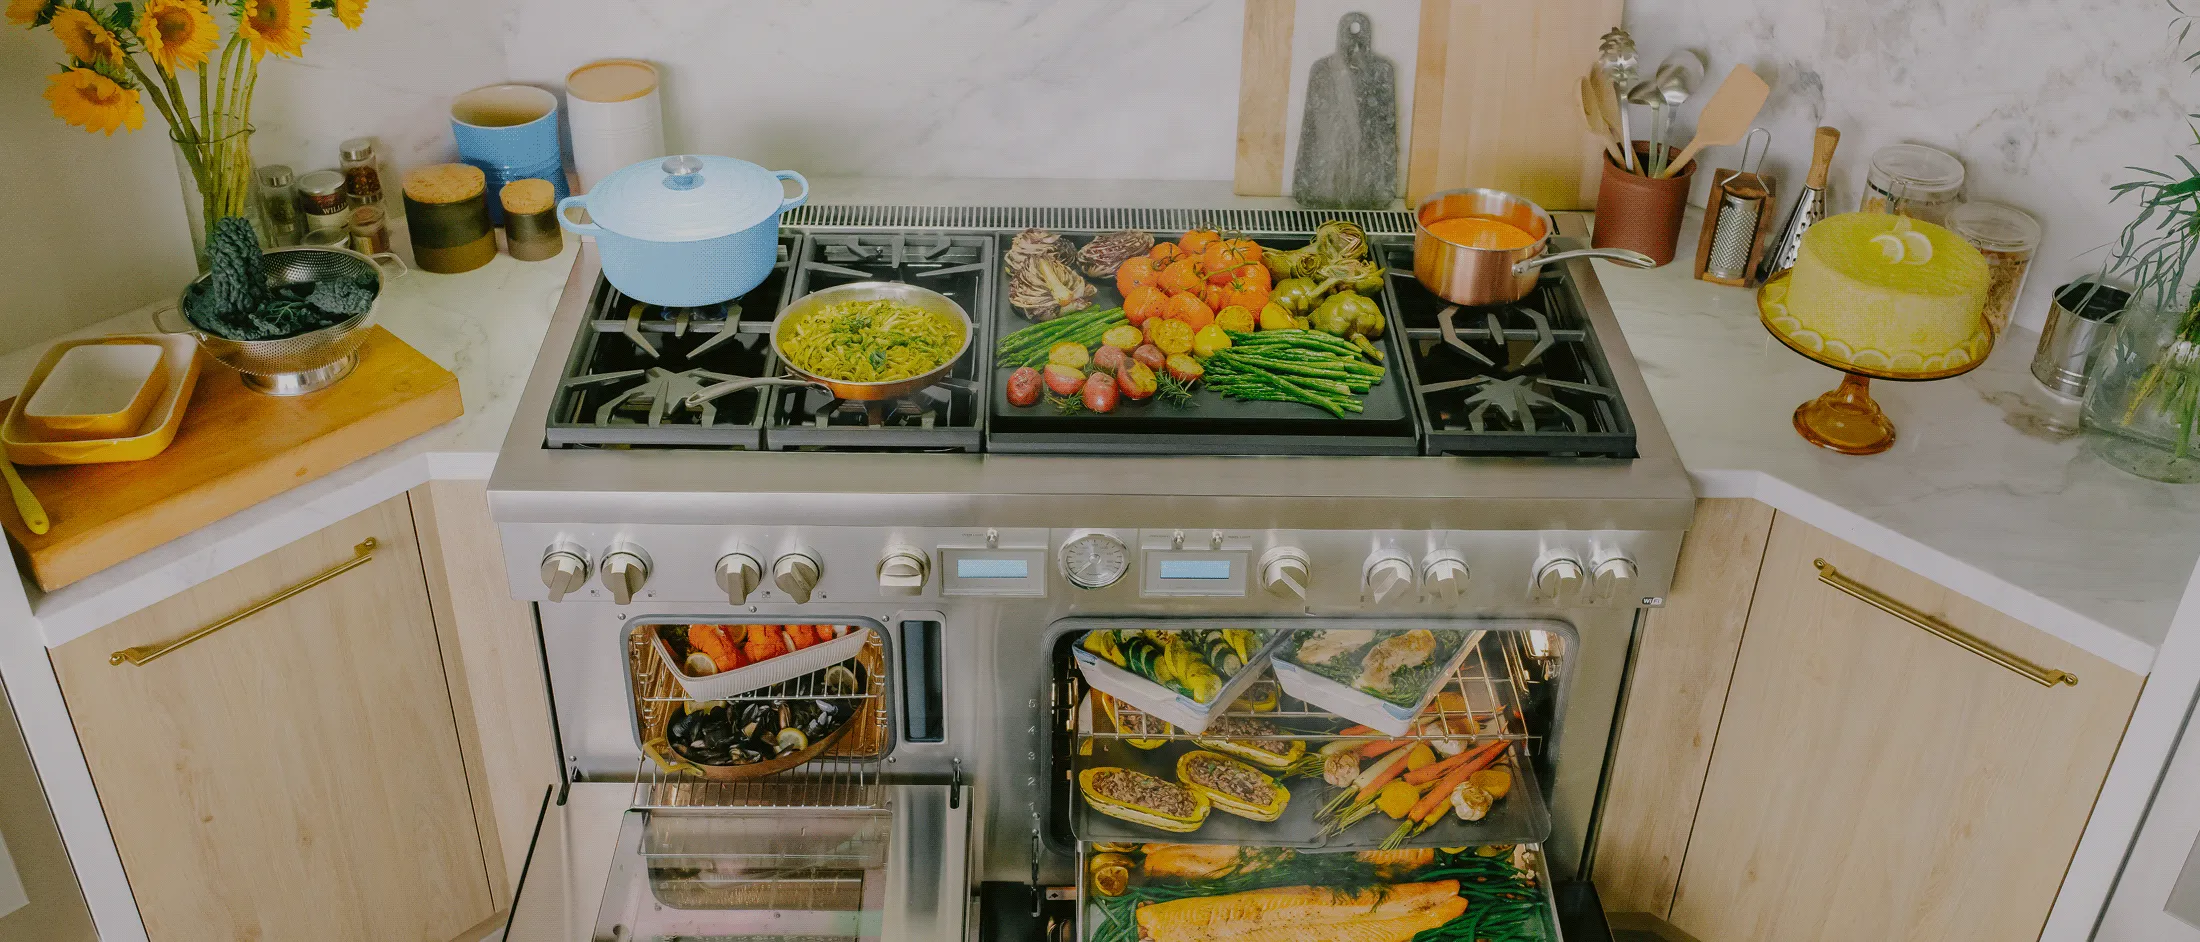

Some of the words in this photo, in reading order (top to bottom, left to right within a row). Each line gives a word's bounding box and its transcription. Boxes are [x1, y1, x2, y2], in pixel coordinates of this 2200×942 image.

[1028, 699, 1036, 708] 5
[1028, 725, 1036, 735] 4
[1028, 752, 1035, 761] 3
[1027, 776, 1036, 786] 2
[1028, 802, 1034, 811] 1
